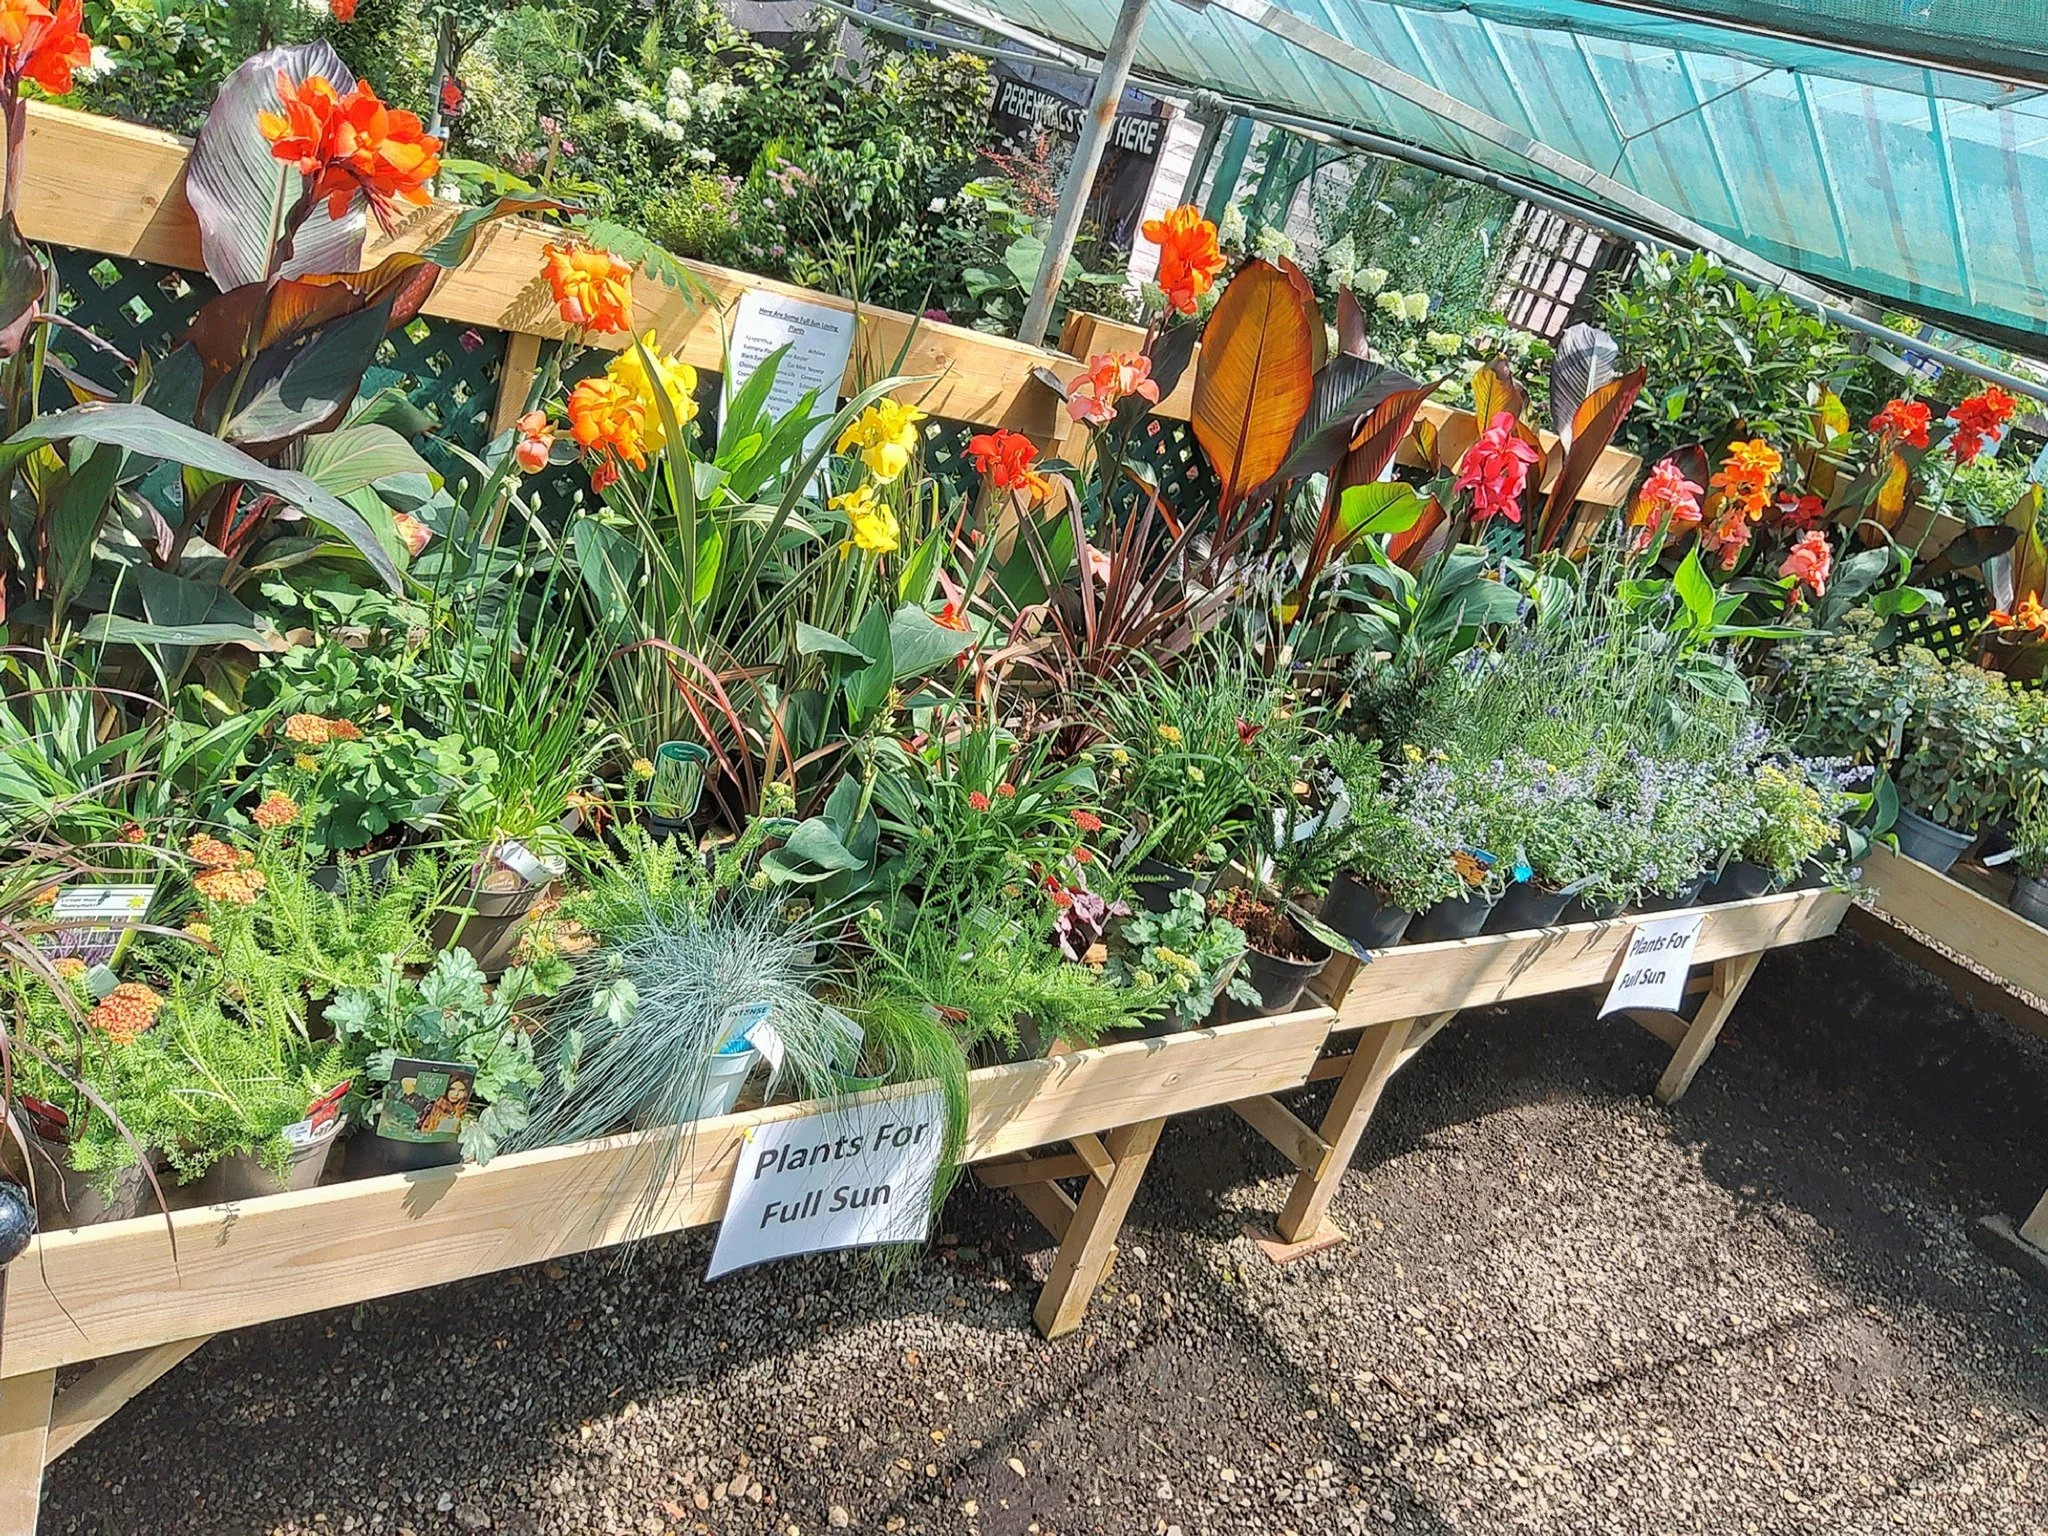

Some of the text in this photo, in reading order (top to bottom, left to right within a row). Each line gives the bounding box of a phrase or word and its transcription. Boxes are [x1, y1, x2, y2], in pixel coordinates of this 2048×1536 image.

[1115, 116, 1159, 155] HERE
[759, 307, 772, 316] Here
[774, 310, 783, 319] Are
[784, 313, 799, 322] Some
[811, 318, 820, 327] Sun
[821, 321, 839, 333] Loving
[788, 325, 805, 335] Plants
[1629, 932, 1690, 957] Plants For
[1618, 968, 1666, 990] Full Sun
[728, 1006, 768, 1017] INTENSE
[754, 1122, 929, 1180] Plants For
[760, 1184, 892, 1229] Full Sun
